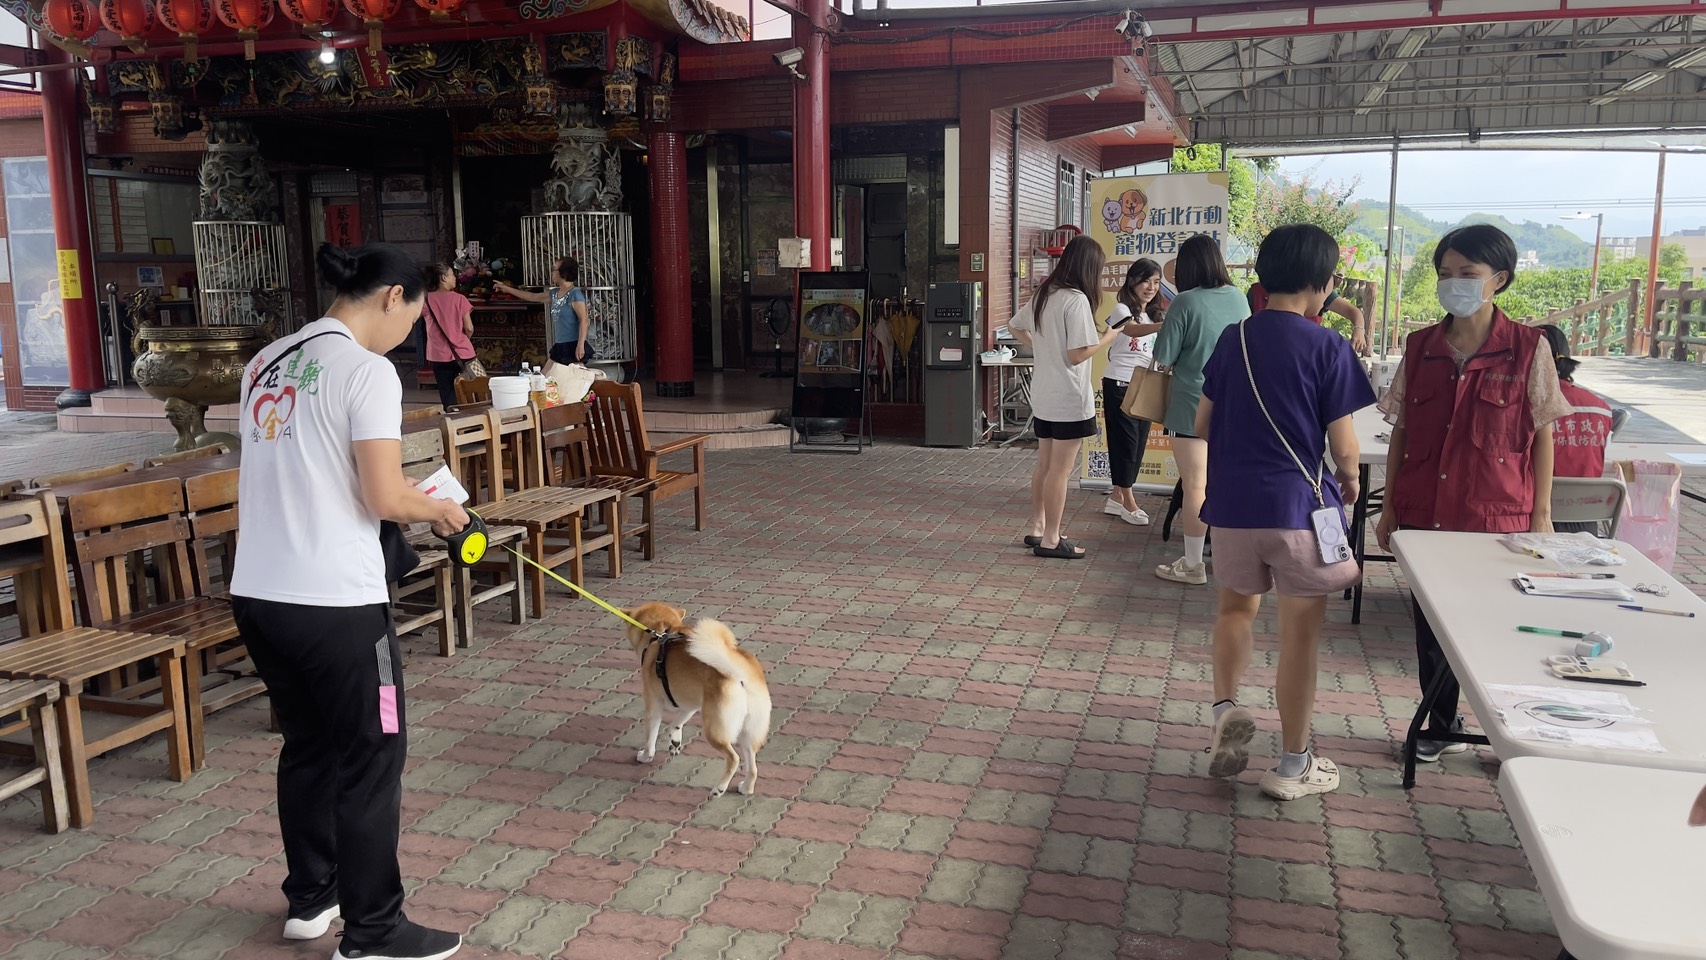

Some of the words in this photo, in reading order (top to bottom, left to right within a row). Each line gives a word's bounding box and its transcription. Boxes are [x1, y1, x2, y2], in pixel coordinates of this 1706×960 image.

[1149, 204, 1223, 227] 新北行動
[1115, 229, 1222, 256] 寵物登
[1101, 263, 1135, 276] 為毛寶
[1552, 434, 1605, 448] 保護防疫
